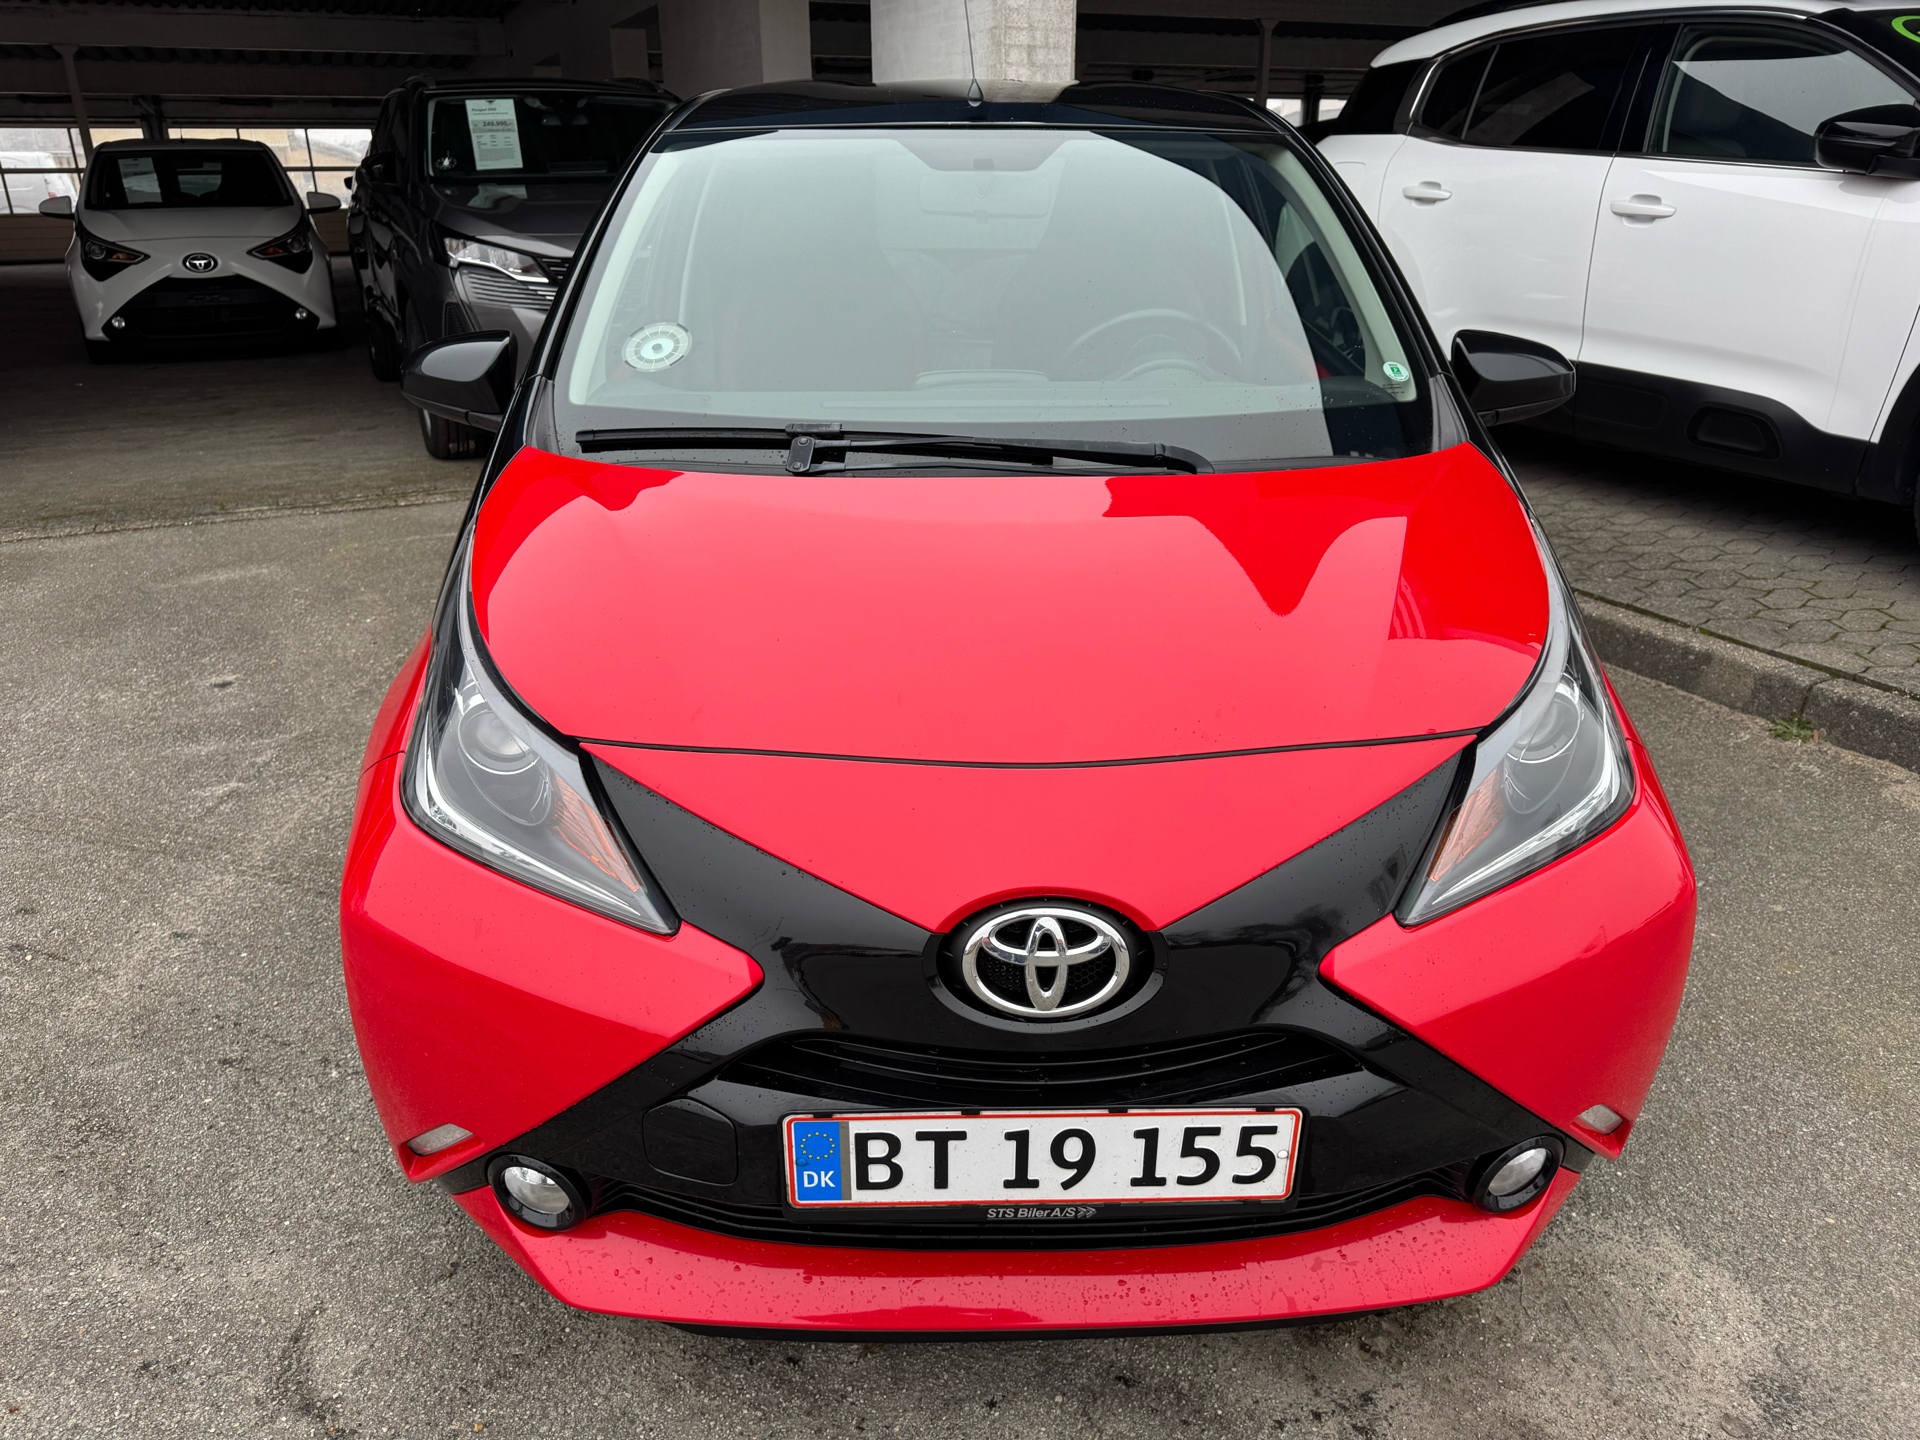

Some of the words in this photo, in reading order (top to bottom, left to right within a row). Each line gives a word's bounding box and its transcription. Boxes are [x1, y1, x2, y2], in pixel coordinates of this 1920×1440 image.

[855, 1129, 968, 1191] BT
[1003, 1127, 1096, 1191] 19
[1129, 1125, 1279, 1187] 155
[803, 1170, 836, 1188] DK
[987, 1208, 1015, 1218] STS
[1017, 1207, 1050, 1218] Biler
[1050, 1207, 1076, 1217] A/S
